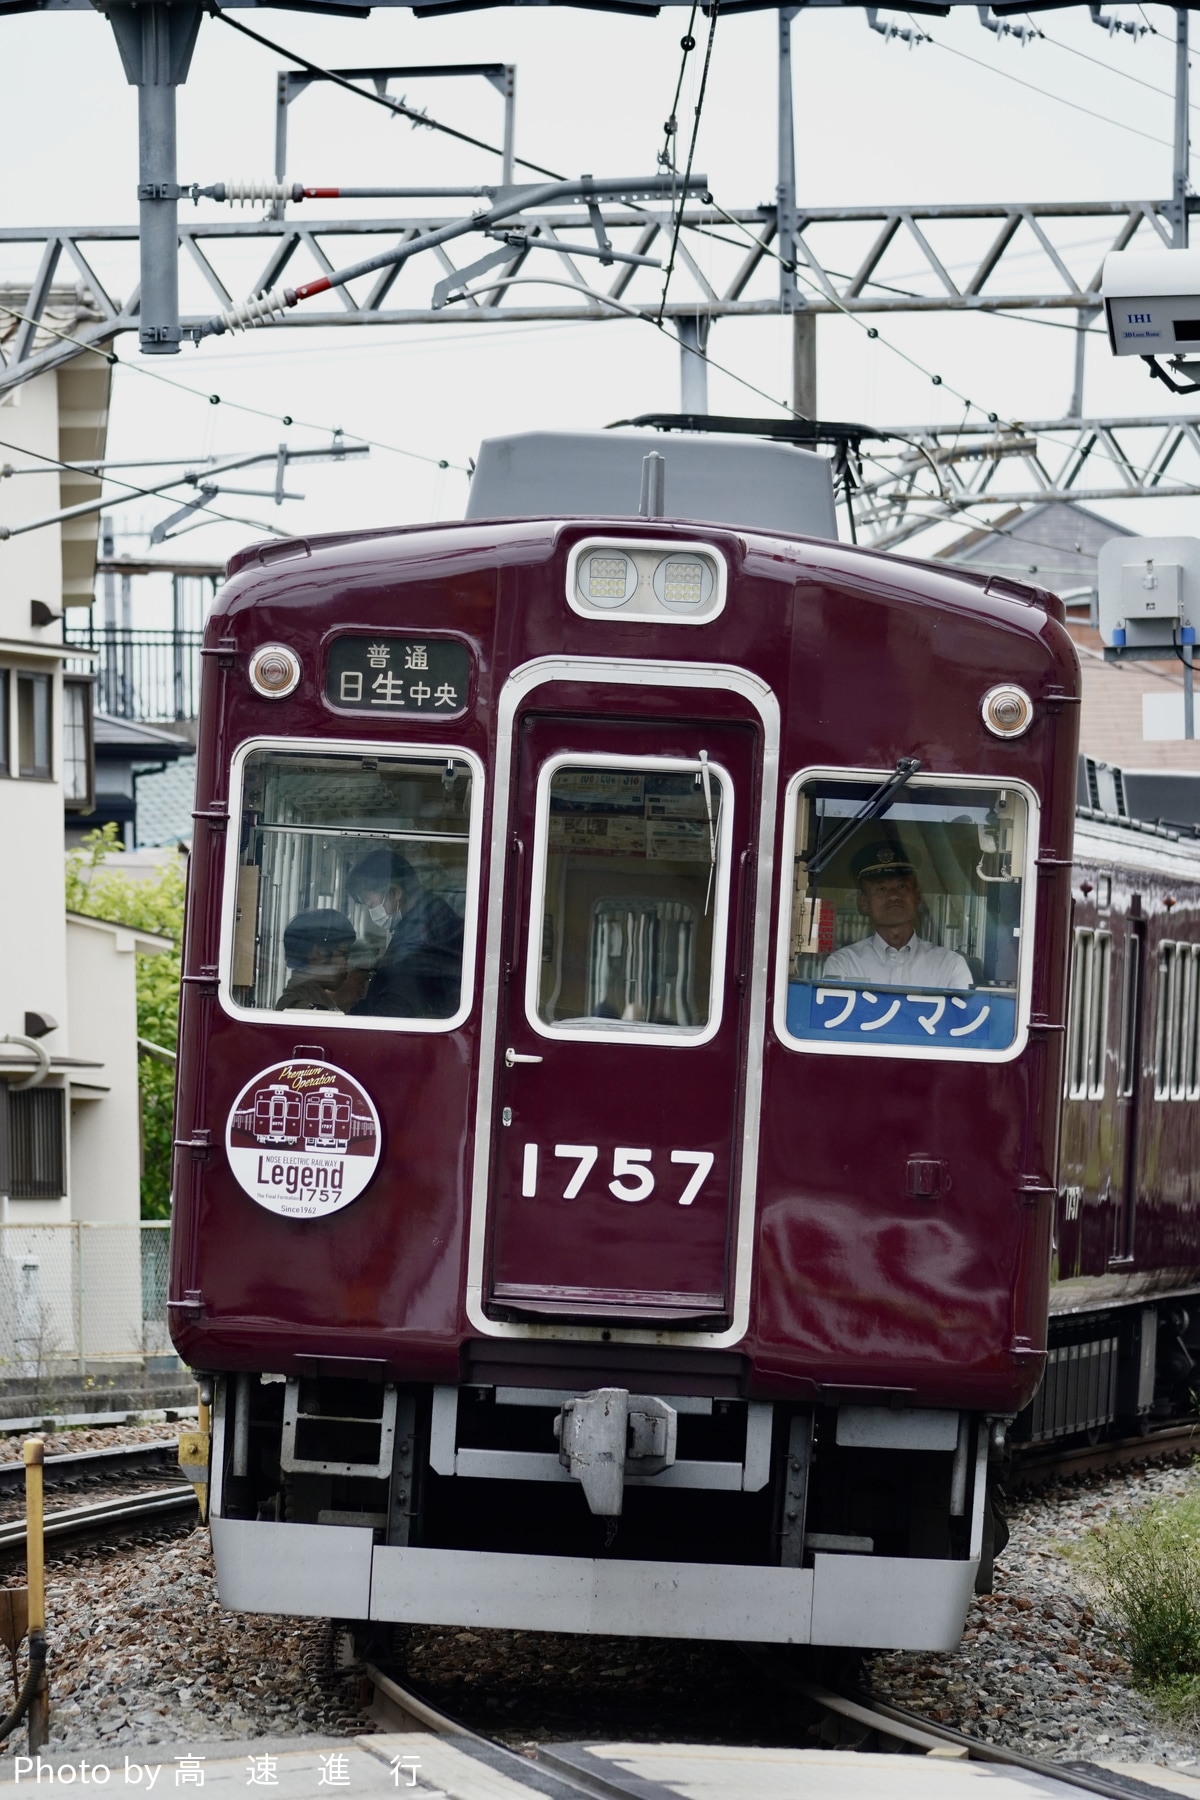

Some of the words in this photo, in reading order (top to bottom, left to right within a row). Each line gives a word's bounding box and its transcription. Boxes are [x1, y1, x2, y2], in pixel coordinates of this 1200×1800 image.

[1128, 314, 1151, 323] IHI
[366, 643, 429, 670] 普通
[340, 671, 458, 707] 日生中央
[816, 988, 990, 1036] ワンマン
[279, 1065, 324, 1080] Premium
[292, 1072, 336, 1092] Operation
[266, 1155, 281, 1164] NOSE
[283, 1156, 310, 1166] ELECTRIC
[311, 1159, 337, 1168] RAILWAY
[257, 1155, 344, 1194] Legend
[522, 1143, 714, 1205] 1757
[300, 1188, 342, 1203] 1757
